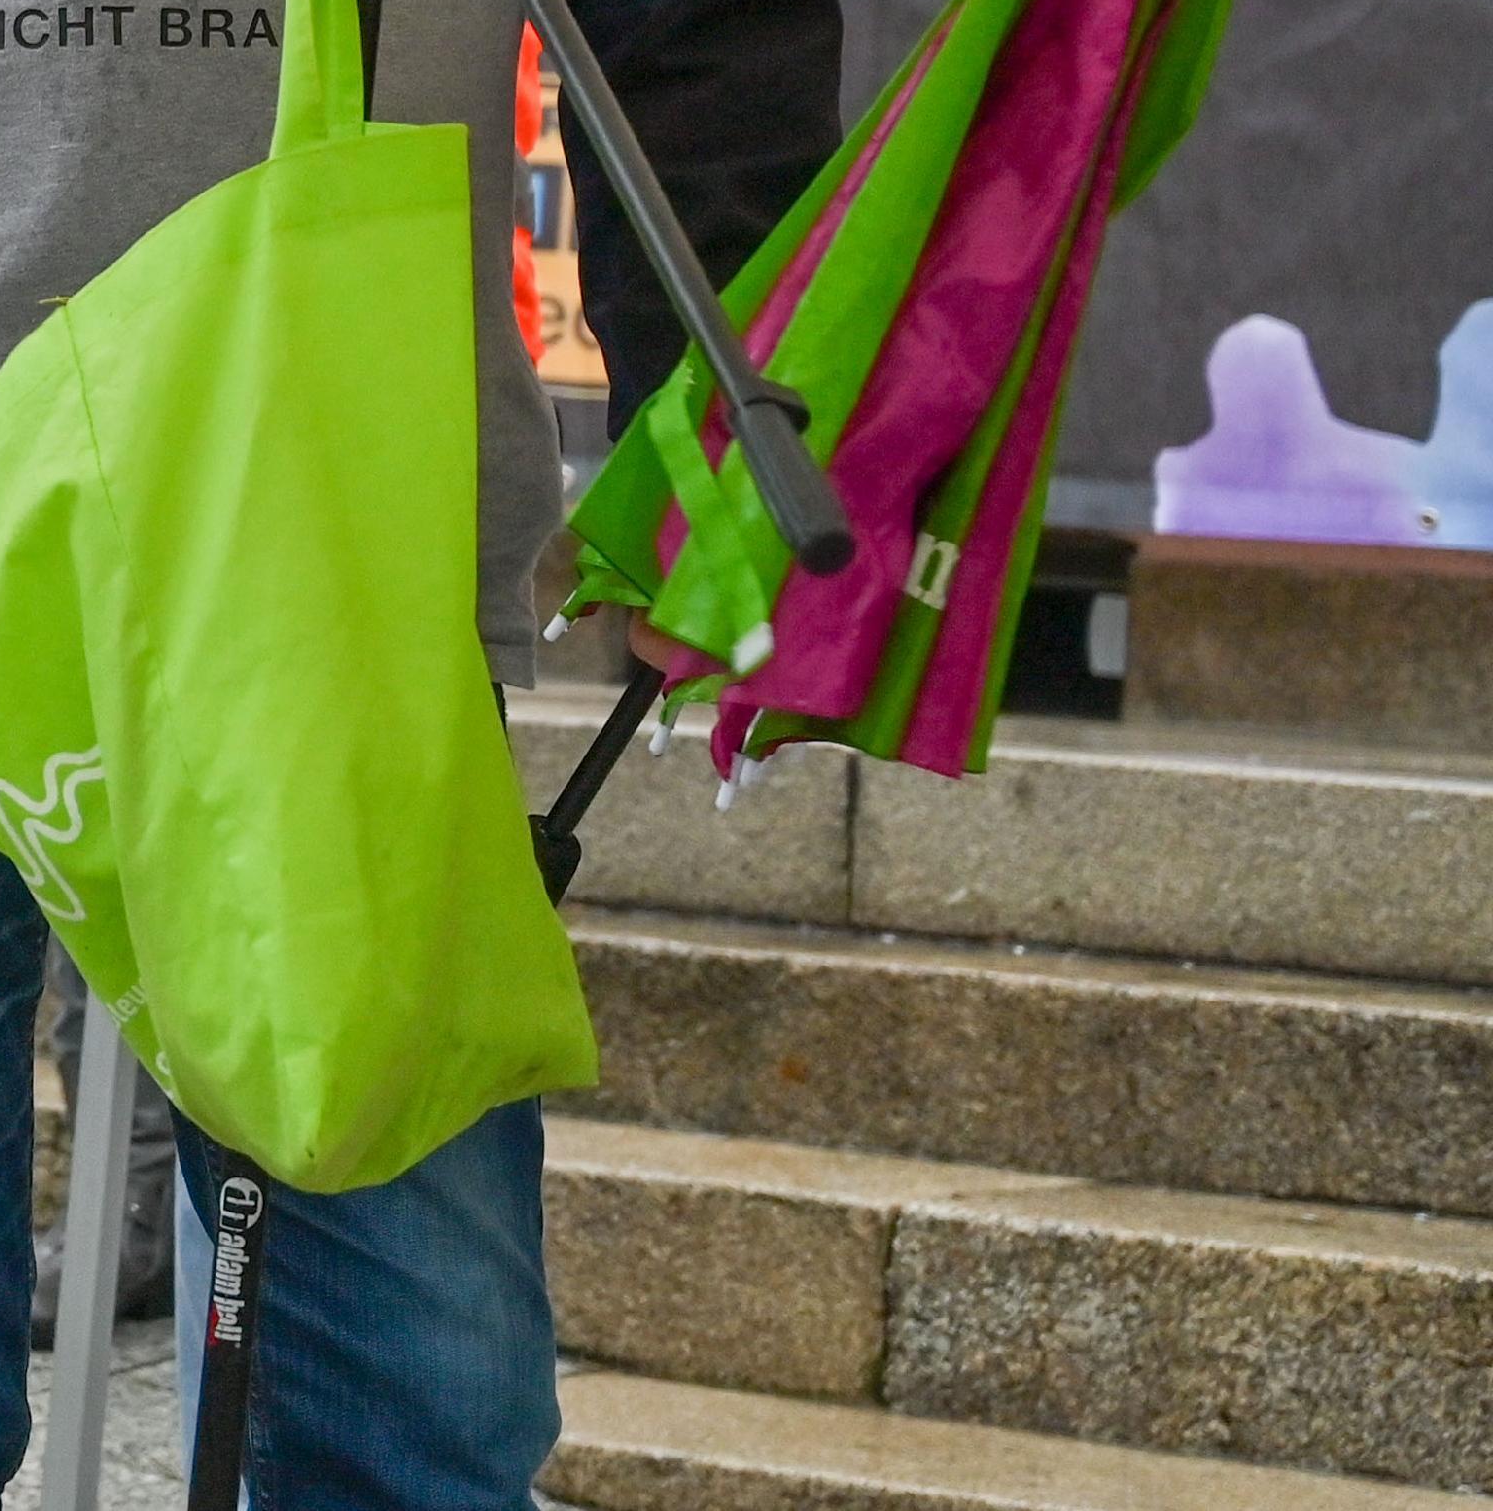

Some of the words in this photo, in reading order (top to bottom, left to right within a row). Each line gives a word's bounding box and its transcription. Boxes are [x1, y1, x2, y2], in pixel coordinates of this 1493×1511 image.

[159, 6, 279, 50] BRA
[214, 1231, 250, 1294] adam
[213, 1294, 246, 1343] hall
